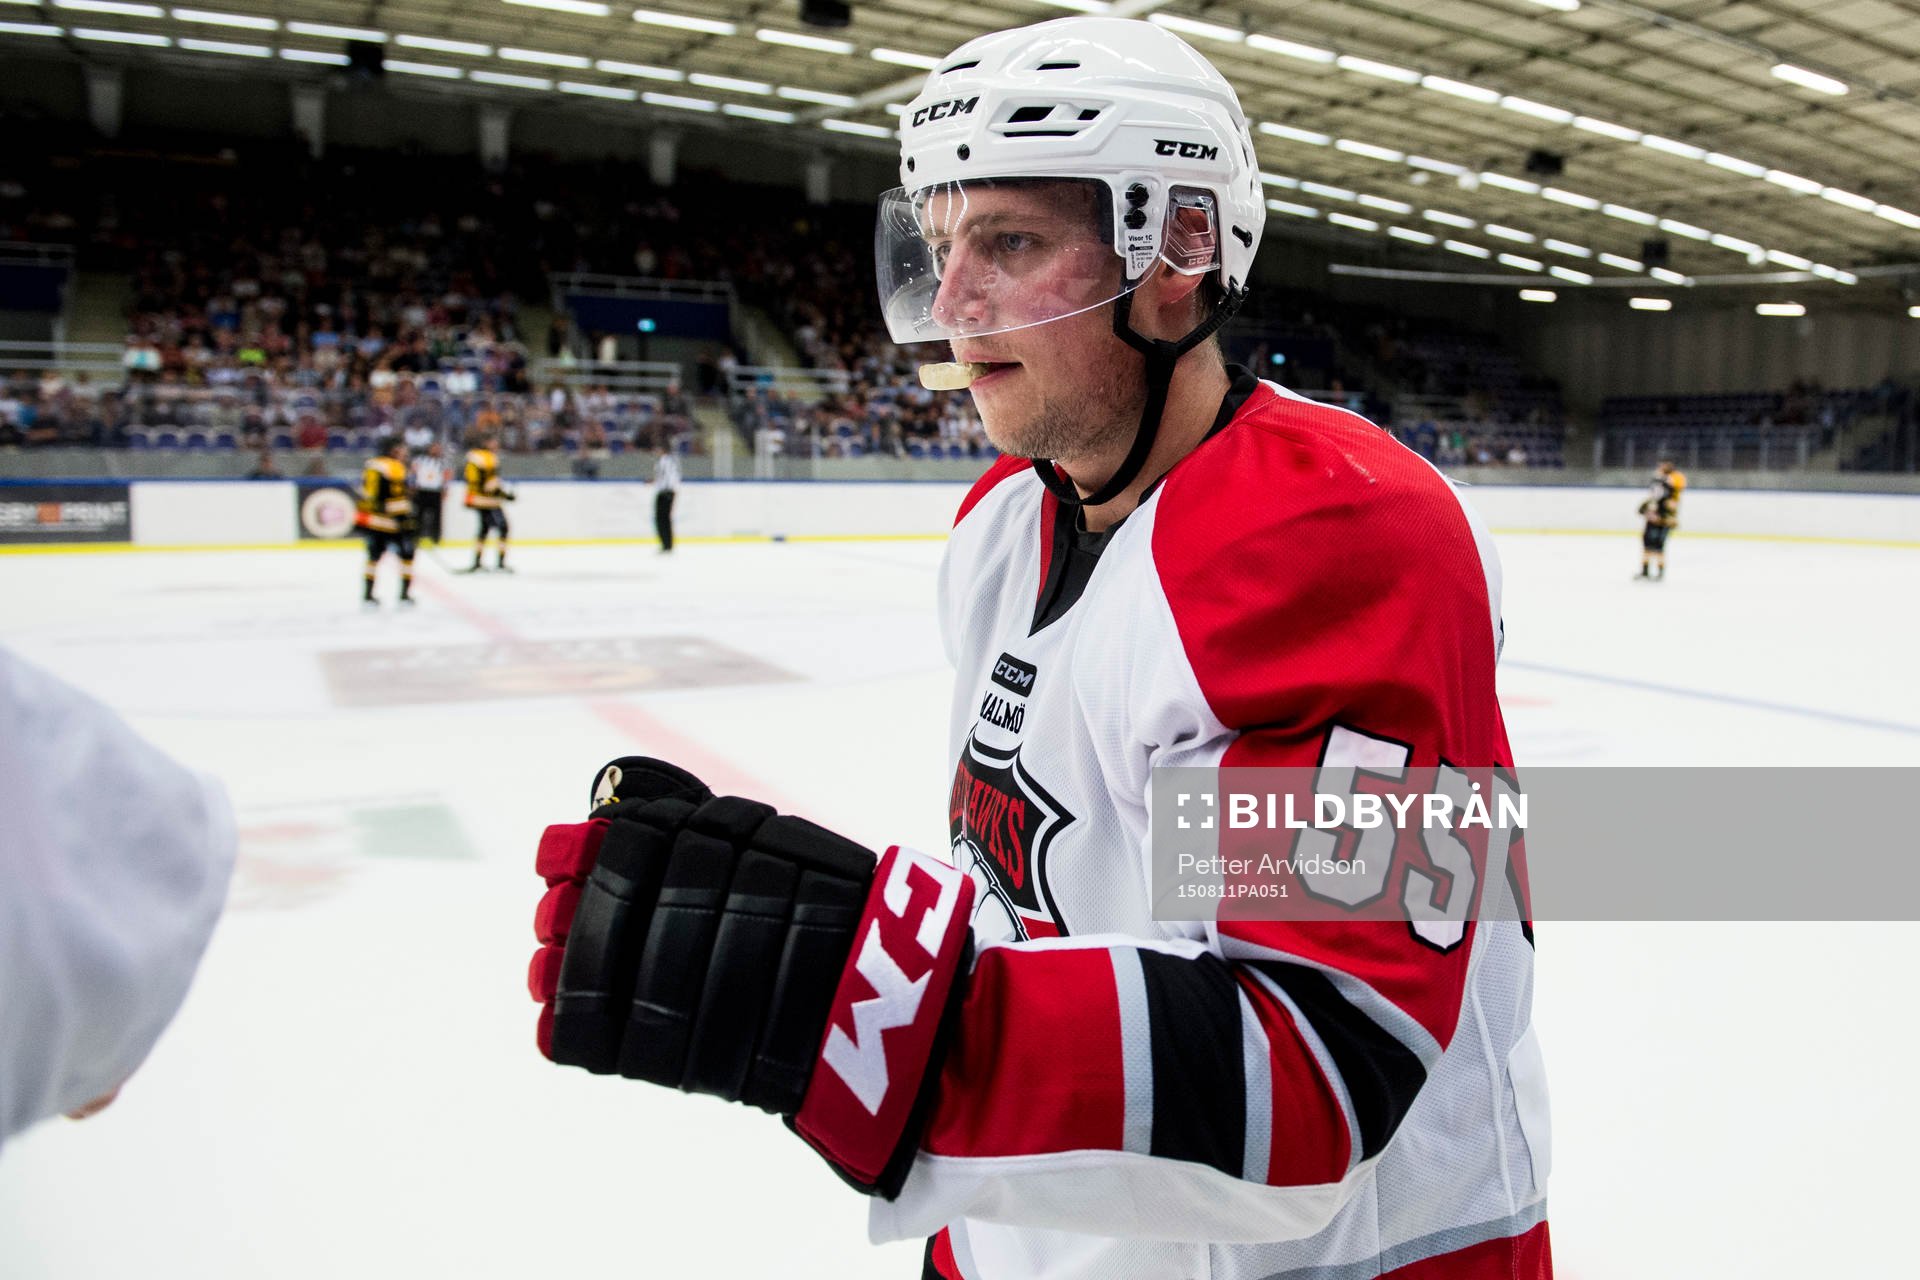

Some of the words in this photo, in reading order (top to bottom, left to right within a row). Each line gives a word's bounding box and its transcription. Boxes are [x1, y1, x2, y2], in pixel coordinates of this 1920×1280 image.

[912, 96, 979, 128] CCM
[1153, 138, 1218, 161] CCM
[994, 659, 1034, 687] CCM
[1292, 721, 1479, 957] 55
[822, 845, 964, 1117] CM
